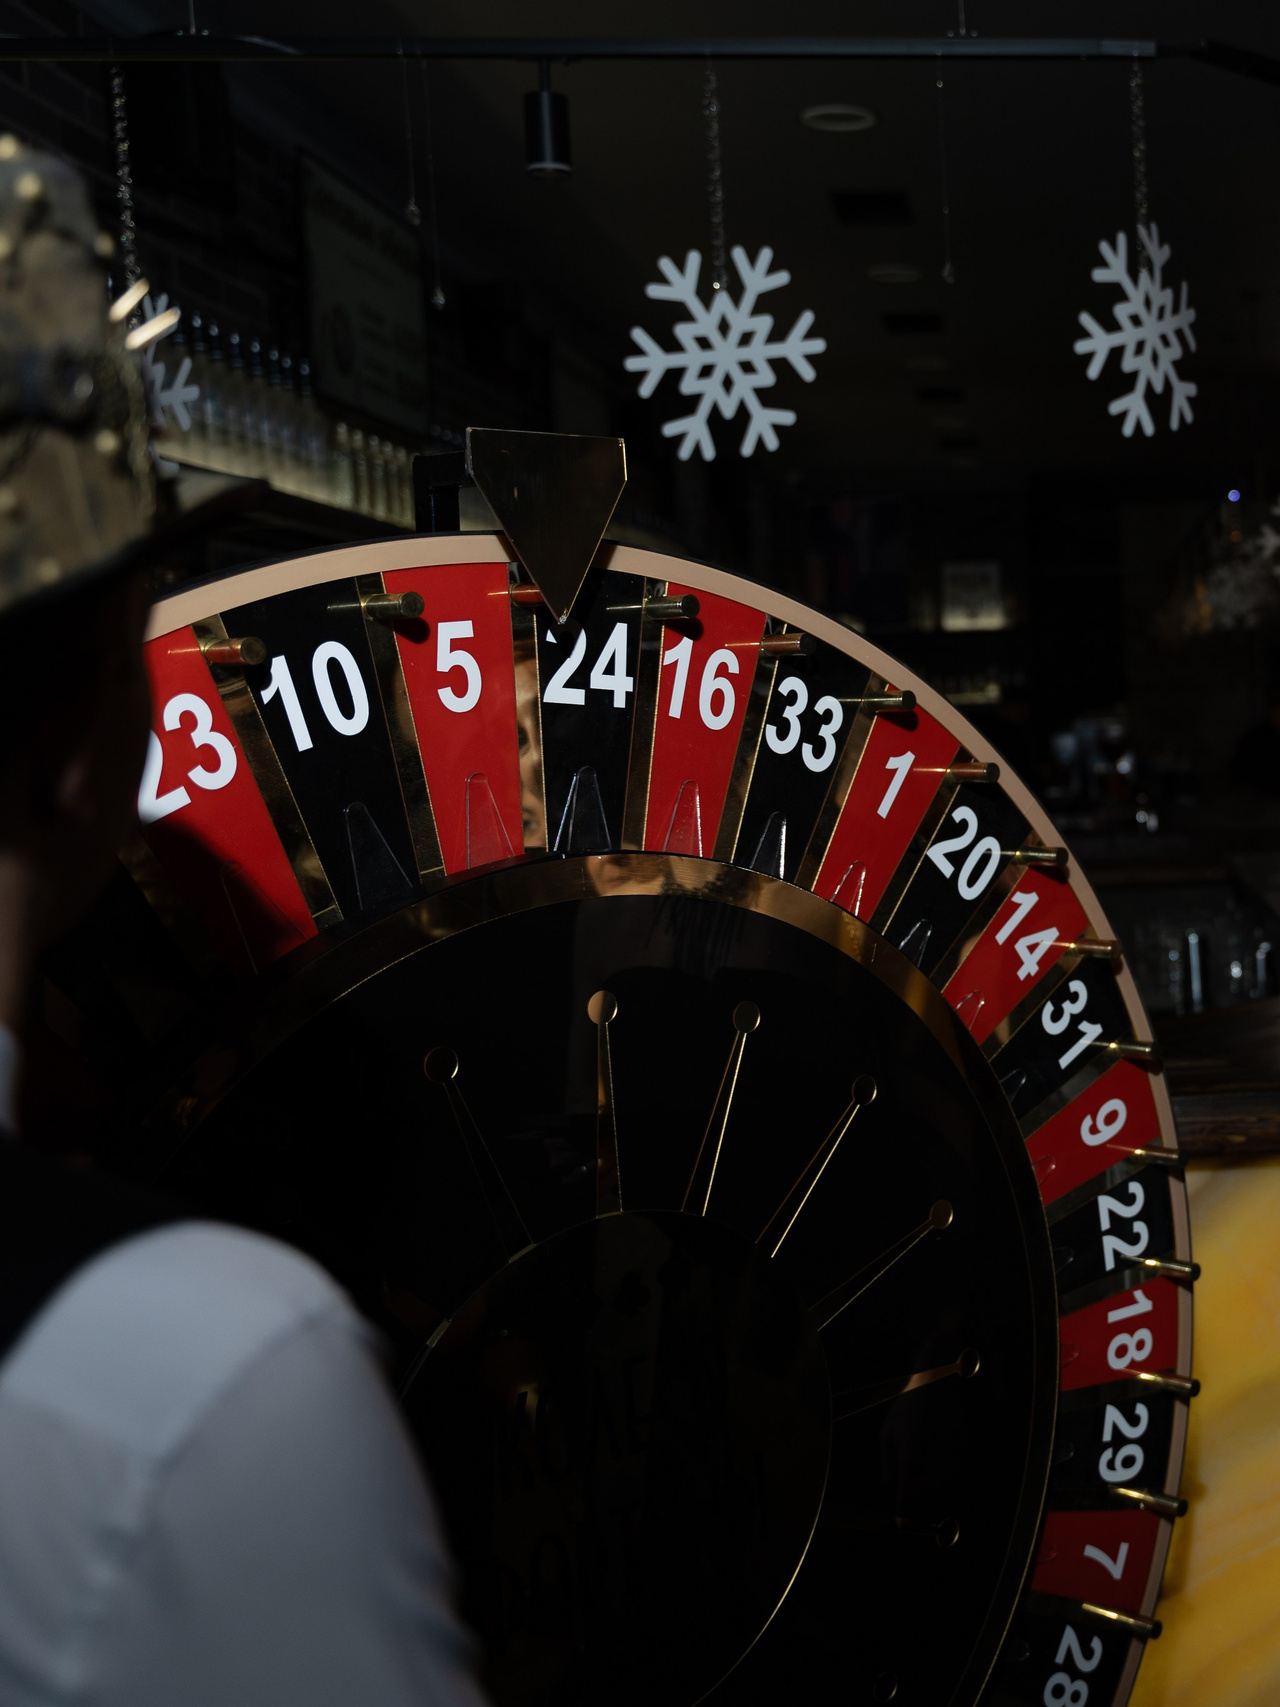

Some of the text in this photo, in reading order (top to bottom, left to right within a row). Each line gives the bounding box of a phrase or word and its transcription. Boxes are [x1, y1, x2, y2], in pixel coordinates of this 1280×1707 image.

[261, 641, 369, 752] 10
[437, 620, 482, 713] 5
[543, 623, 633, 708] 24
[663, 637, 739, 730] 16
[138, 693, 237, 820] 23
[766, 677, 843, 772] 33
[877, 751, 915, 819] 1
[926, 806, 1004, 900] 20
[995, 892, 1059, 980] 14
[1042, 980, 1102, 1069] 31
[1081, 1099, 1126, 1146] 9
[1098, 1182, 1148, 1270] 22
[1108, 1290, 1152, 1369] 18
[1099, 1403, 1148, 1481] 29
[1084, 1542, 1129, 1580] 7
[1043, 1625, 1102, 1707] 28
